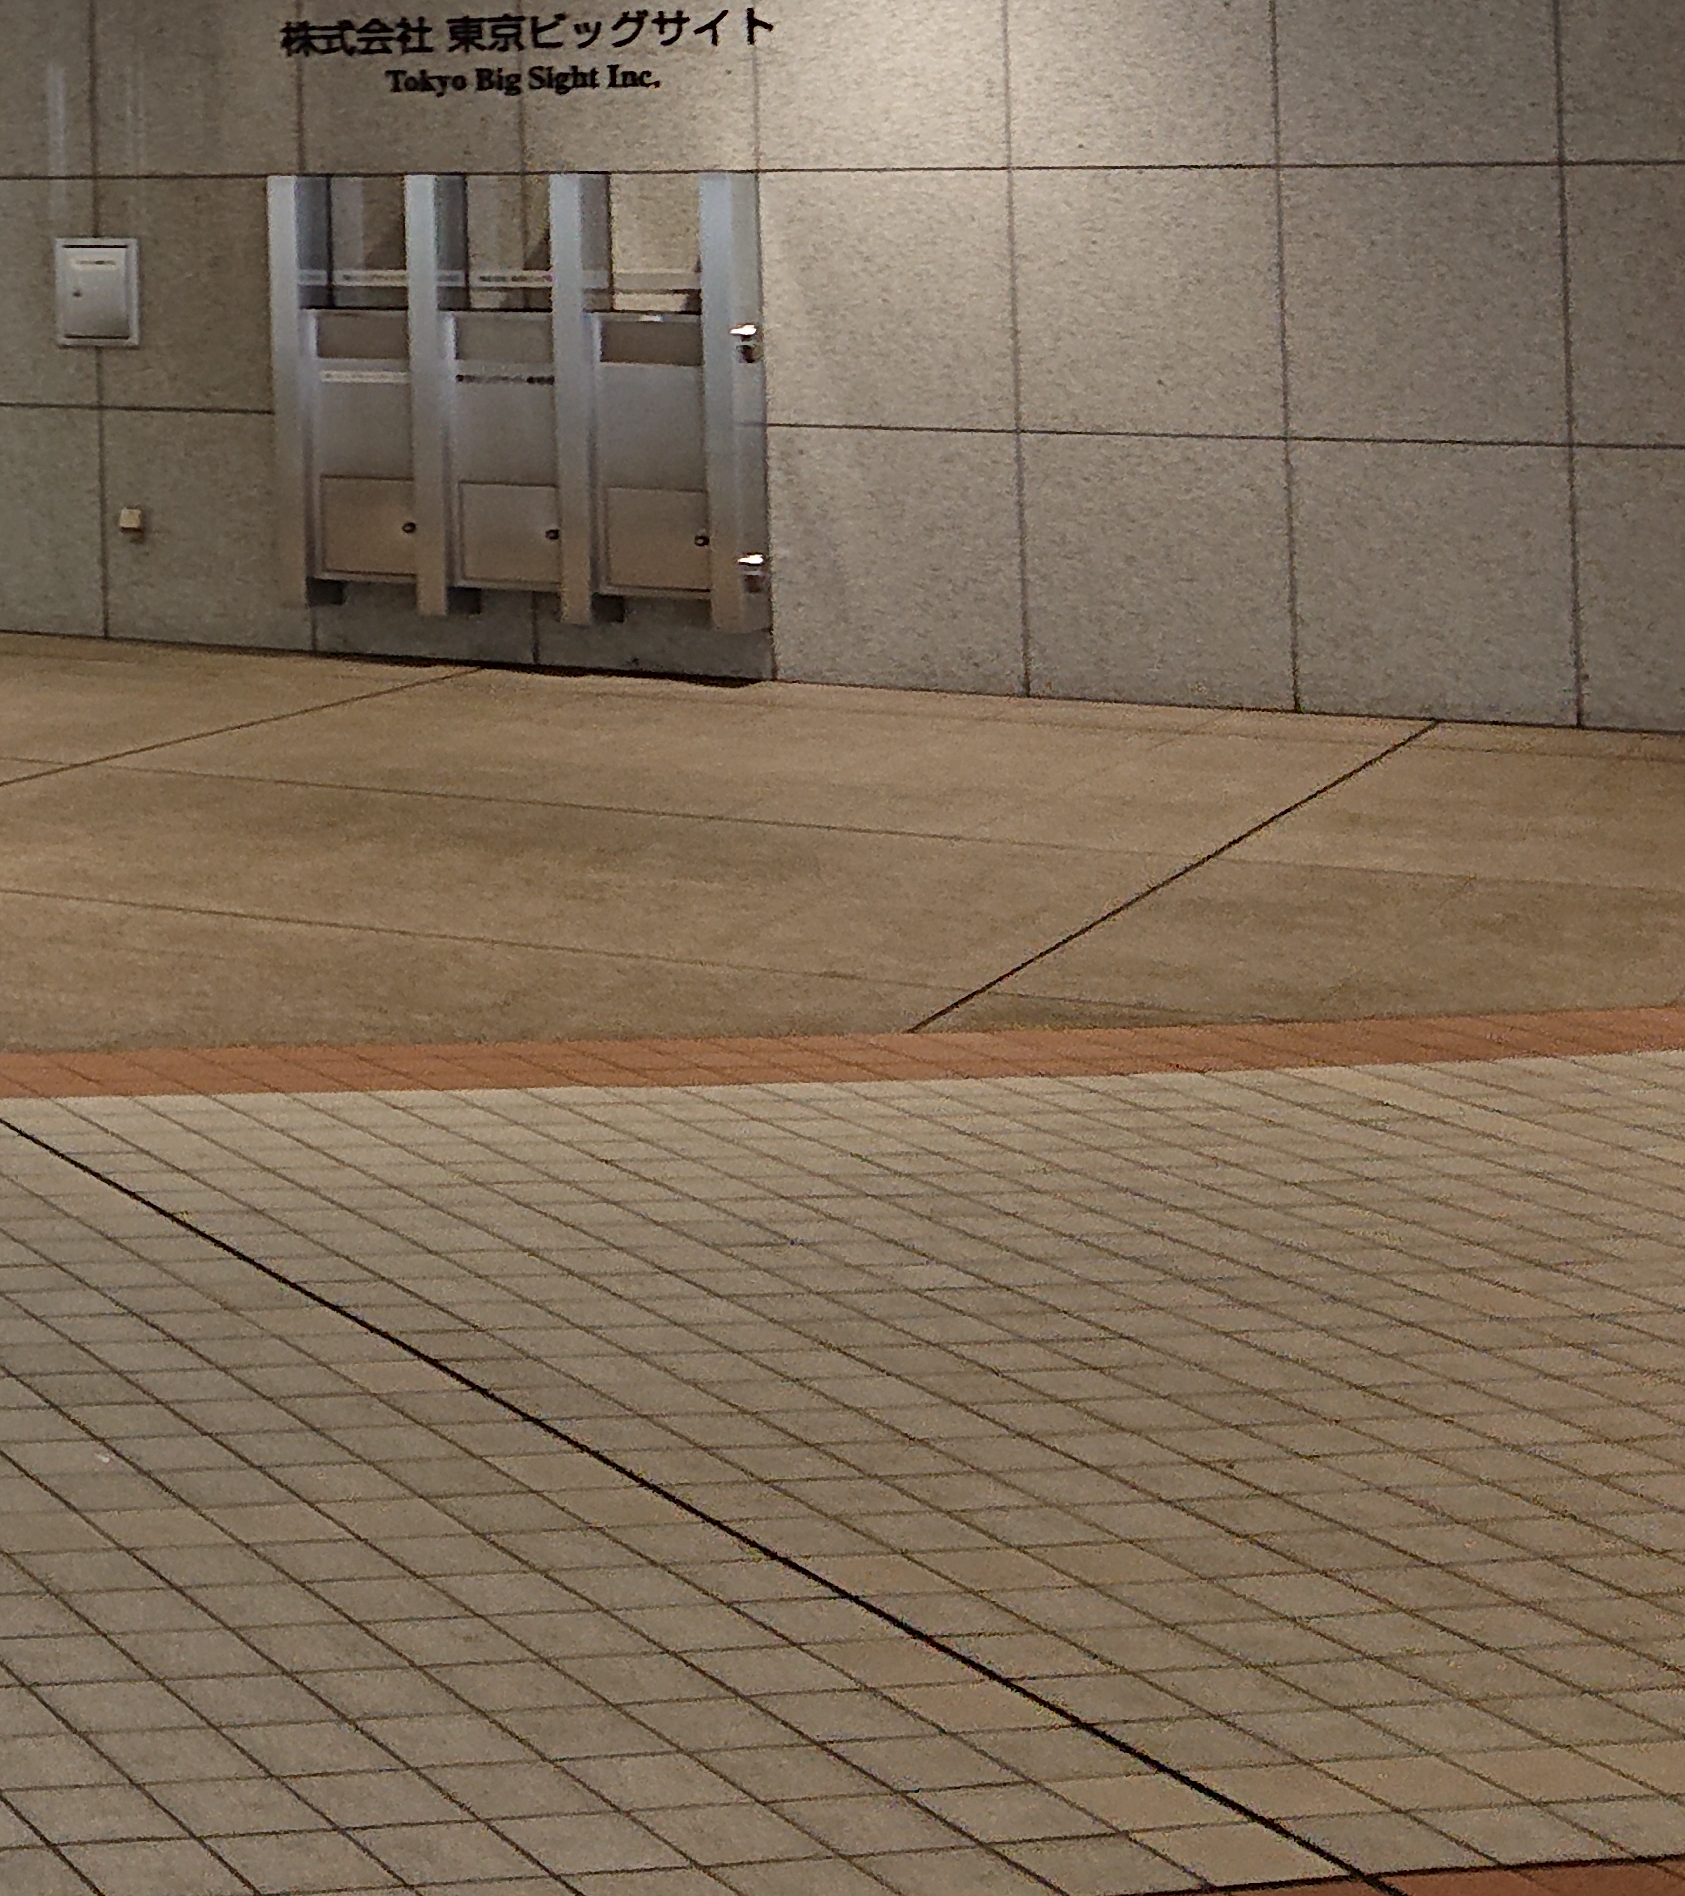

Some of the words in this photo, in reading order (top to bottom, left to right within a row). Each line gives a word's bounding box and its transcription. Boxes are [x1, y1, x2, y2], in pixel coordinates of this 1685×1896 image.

[279, 18, 434, 57] 株式会社
[445, 7, 774, 53] 東京ビッグサイト
[384, 69, 468, 98] Tokyo
[474, 67, 523, 97] Big
[528, 64, 601, 96] Sight
[606, 64, 661, 89] Inc.
